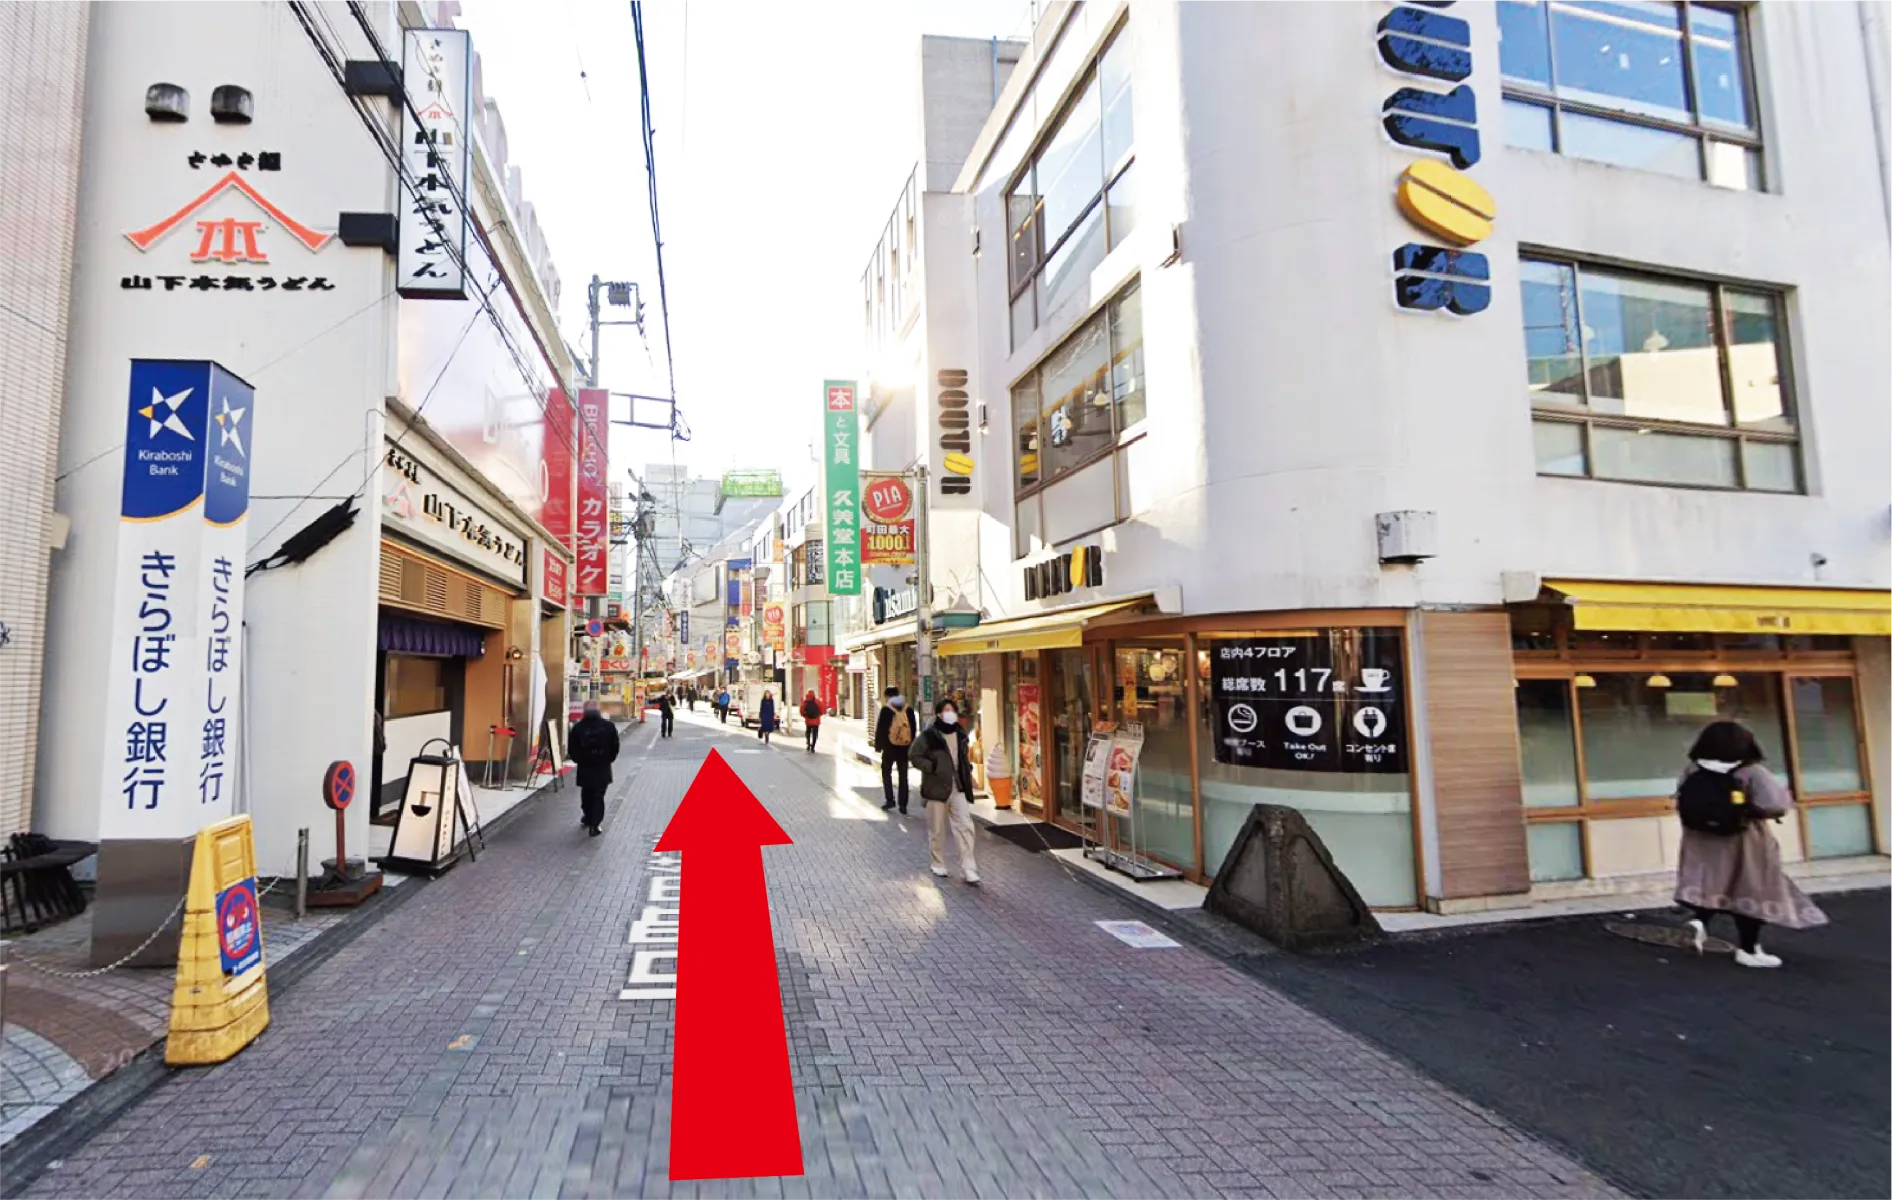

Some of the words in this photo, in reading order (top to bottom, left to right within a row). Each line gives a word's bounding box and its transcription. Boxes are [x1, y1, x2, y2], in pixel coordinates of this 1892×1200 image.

[1376, 0, 1496, 315] UTOR
[138, 449, 193, 461] Kiraboshi
[149, 465, 179, 476] Bank
[872, 485, 902, 508] PIA
[579, 497, 604, 584] カラオケ
[832, 489, 856, 590] 久美堂本店
[123, 549, 176, 810] きらぼし銀行
[199, 555, 233, 805] きらぼし銀行
[1220, 646, 1297, 660] 店内4フロア
[1283, 741, 1306, 751] Take
